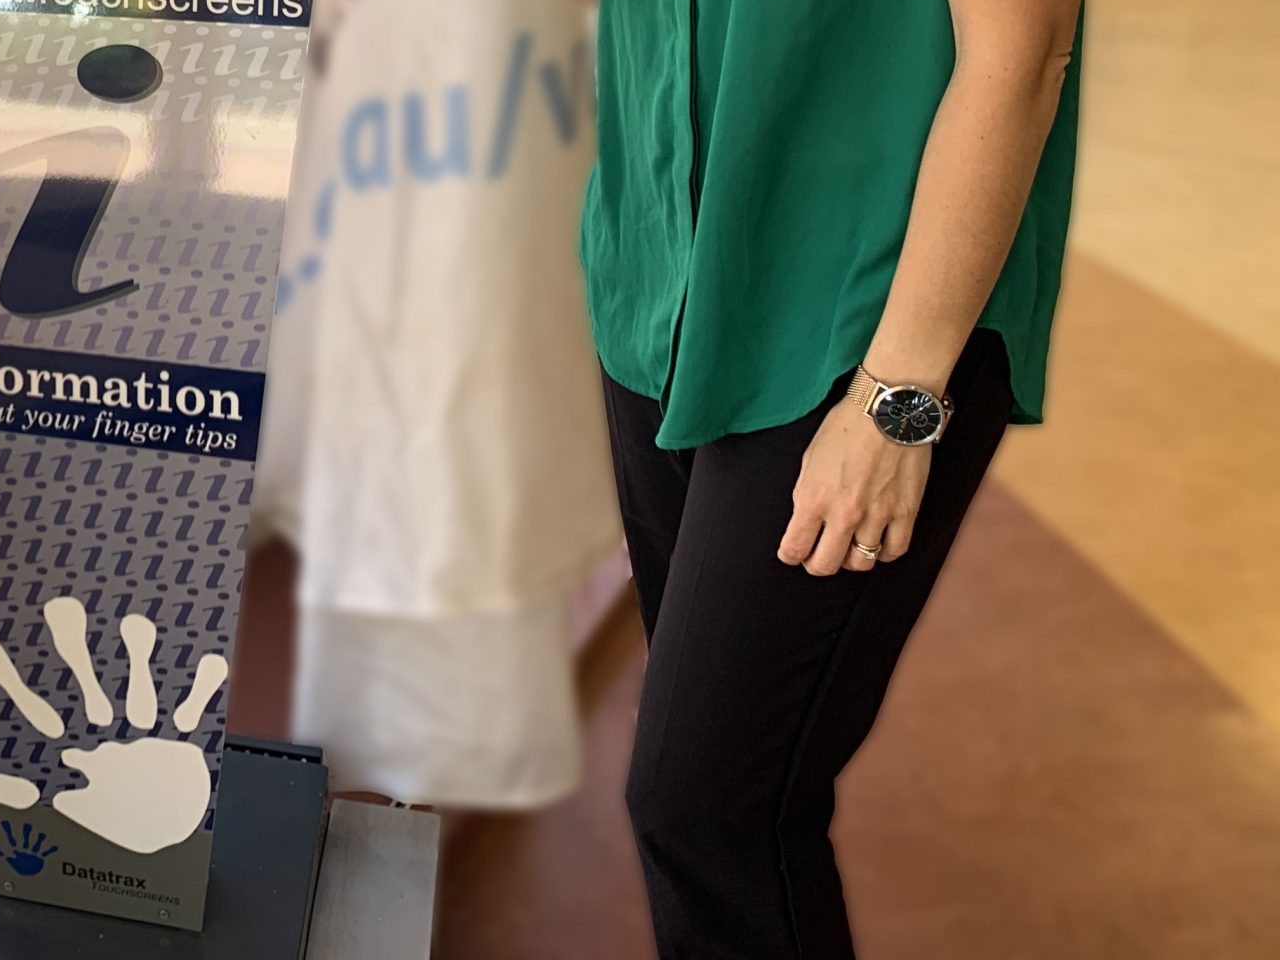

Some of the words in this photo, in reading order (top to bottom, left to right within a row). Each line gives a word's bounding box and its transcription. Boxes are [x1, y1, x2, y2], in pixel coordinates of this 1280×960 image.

[21, 408, 85, 432] your
[91, 410, 177, 445] finger
[185, 423, 238, 453] tips
[61, 861, 147, 890] Datatrax
[90, 881, 181, 906] TOUCHSCREENS
